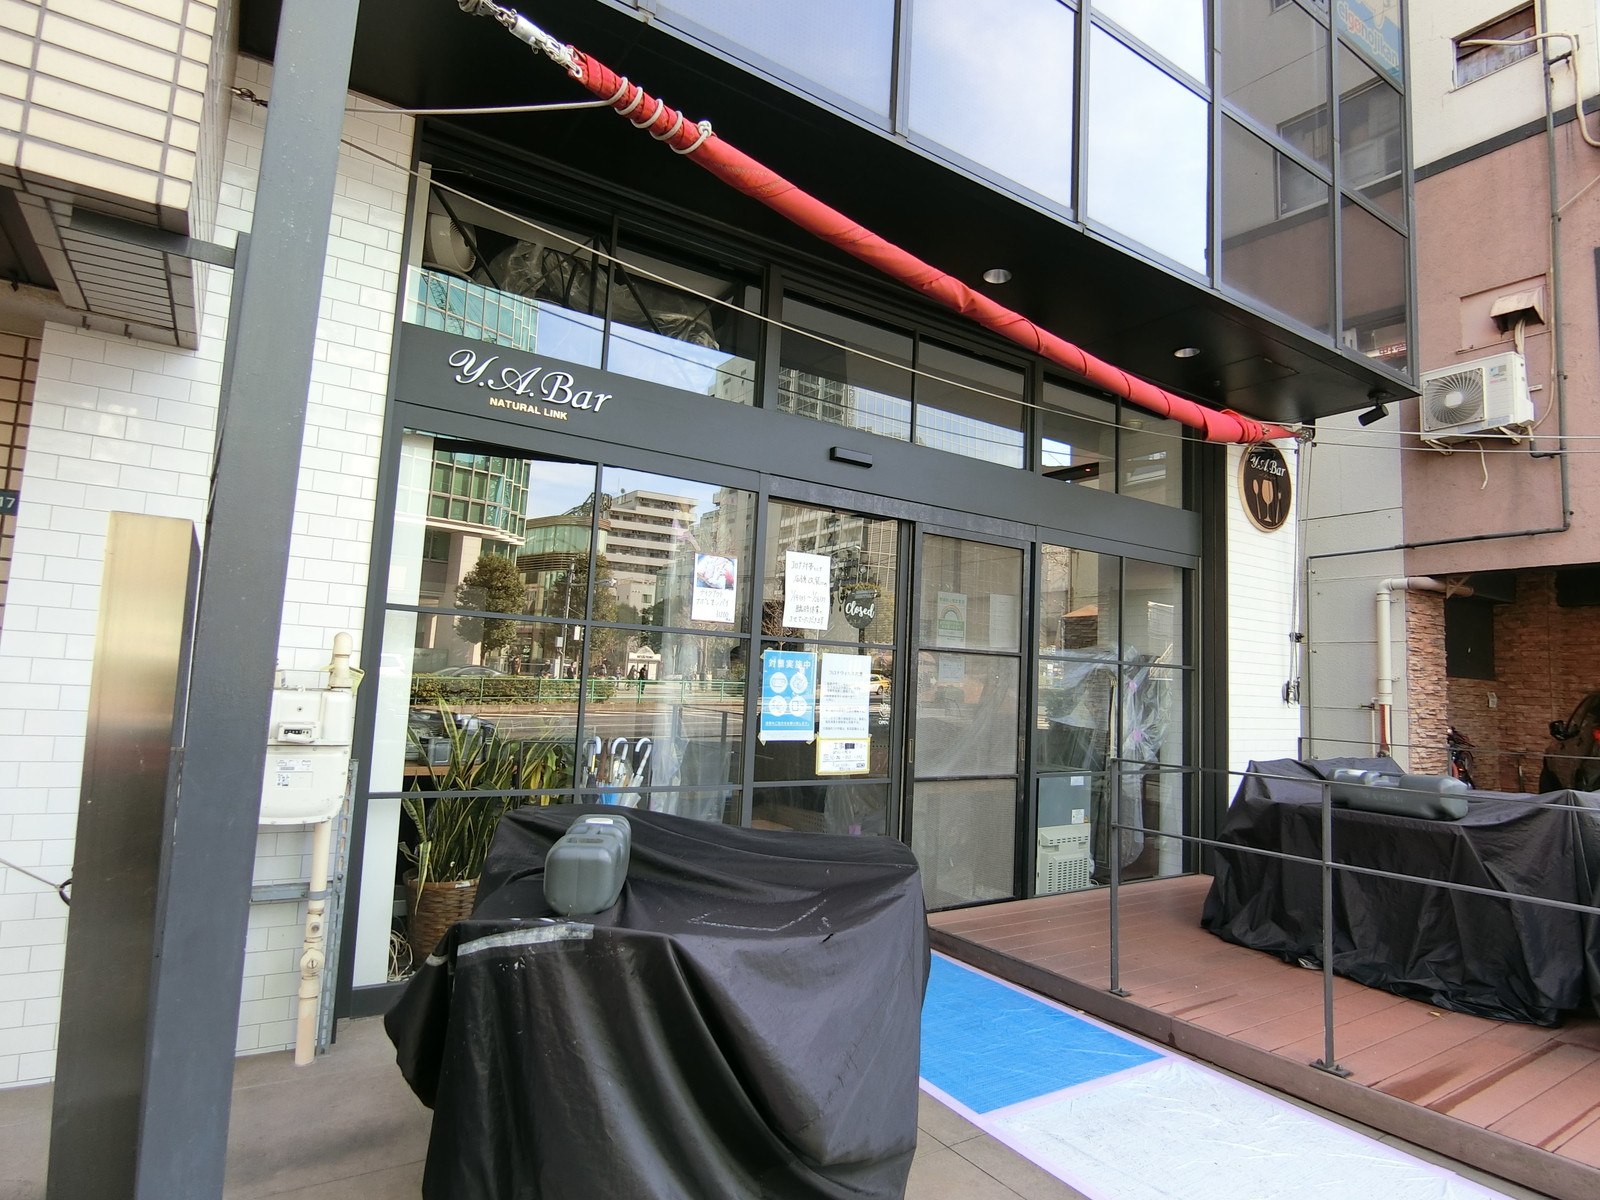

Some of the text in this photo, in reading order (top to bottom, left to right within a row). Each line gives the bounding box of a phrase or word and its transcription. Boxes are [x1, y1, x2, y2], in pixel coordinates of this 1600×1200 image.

[448, 349, 612, 412] Y.A.Bar
[489, 397, 569, 421] NATURAL LINK
[845, 600, 875, 618] Closed
